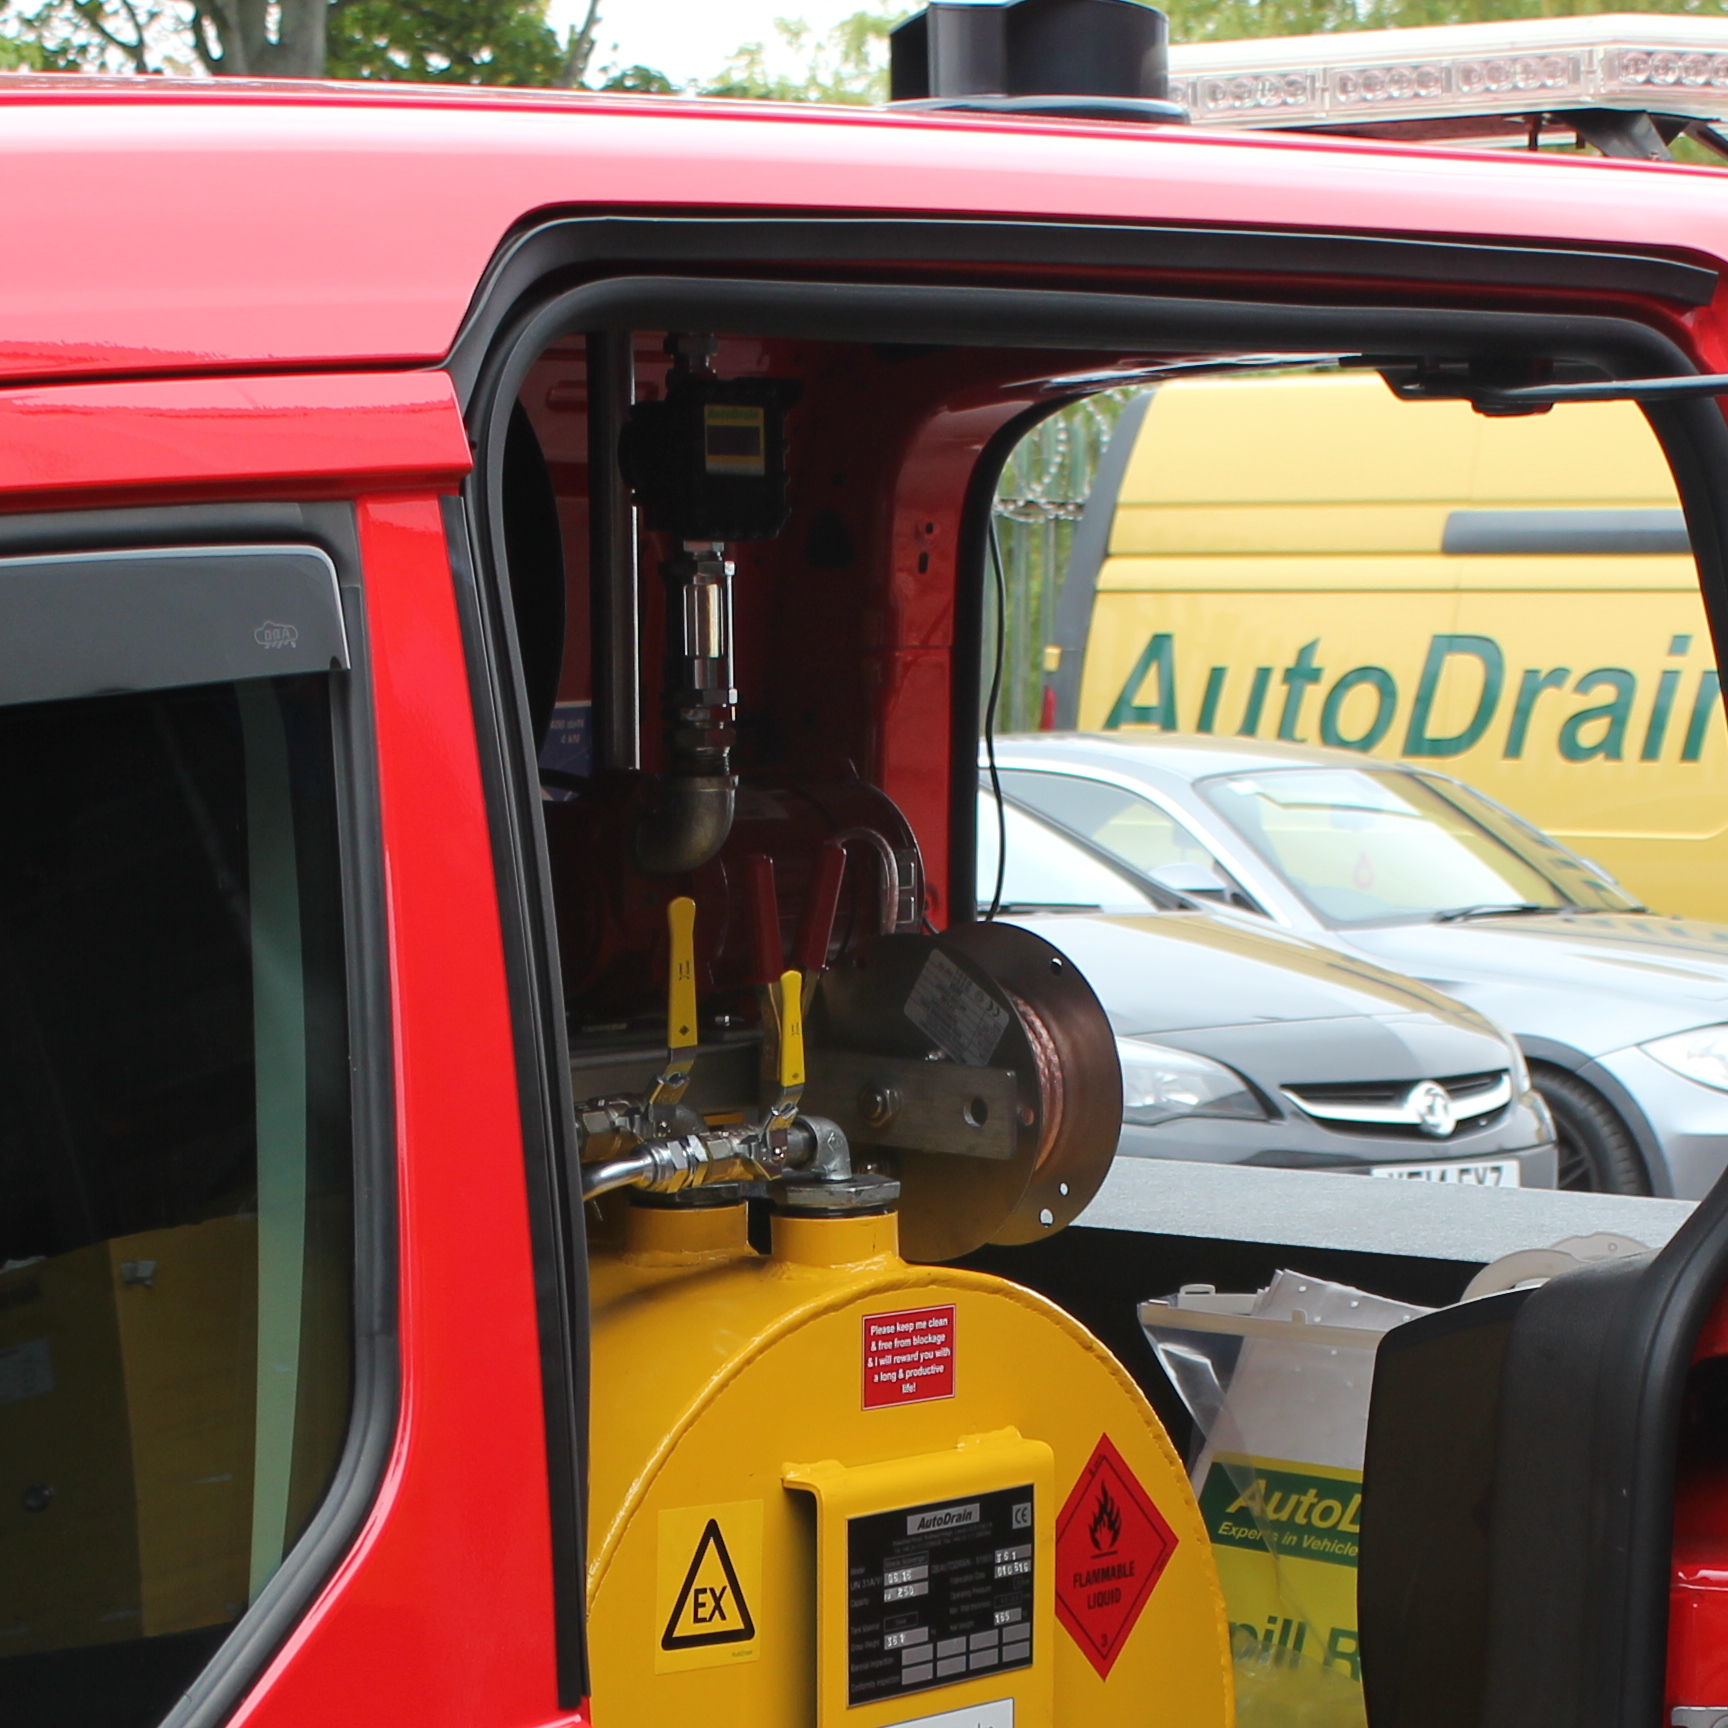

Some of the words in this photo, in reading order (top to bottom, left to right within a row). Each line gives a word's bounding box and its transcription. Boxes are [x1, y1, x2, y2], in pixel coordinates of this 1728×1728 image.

[870, 1325, 895, 1336] Please
[896, 1322, 914, 1333] keep
[915, 1321, 927, 1330] me
[928, 1317, 948, 1327] clean
[878, 1340, 893, 1350] free
[894, 1338, 912, 1348] from
[913, 1333, 946, 1346] blockage
[879, 1354, 892, 1365] will
[893, 1351, 919, 1363] reward
[920, 1350, 933, 1363] you
[934, 1347, 951, 1358] with
[880, 1371, 896, 1383] long
[905, 1364, 944, 1380] productive
[917, 1509, 972, 1531] AutoDrain
[1281, 1531, 1297, 1546] in
[1302, 1535, 1358, 1557] Vehicle
[1073, 1561, 1135, 1589] FLAMMABLE
[693, 1585, 727, 1624] EX
[1087, 1587, 1121, 1611] LIQUID
[1100, 1634, 1109, 1648] 3
